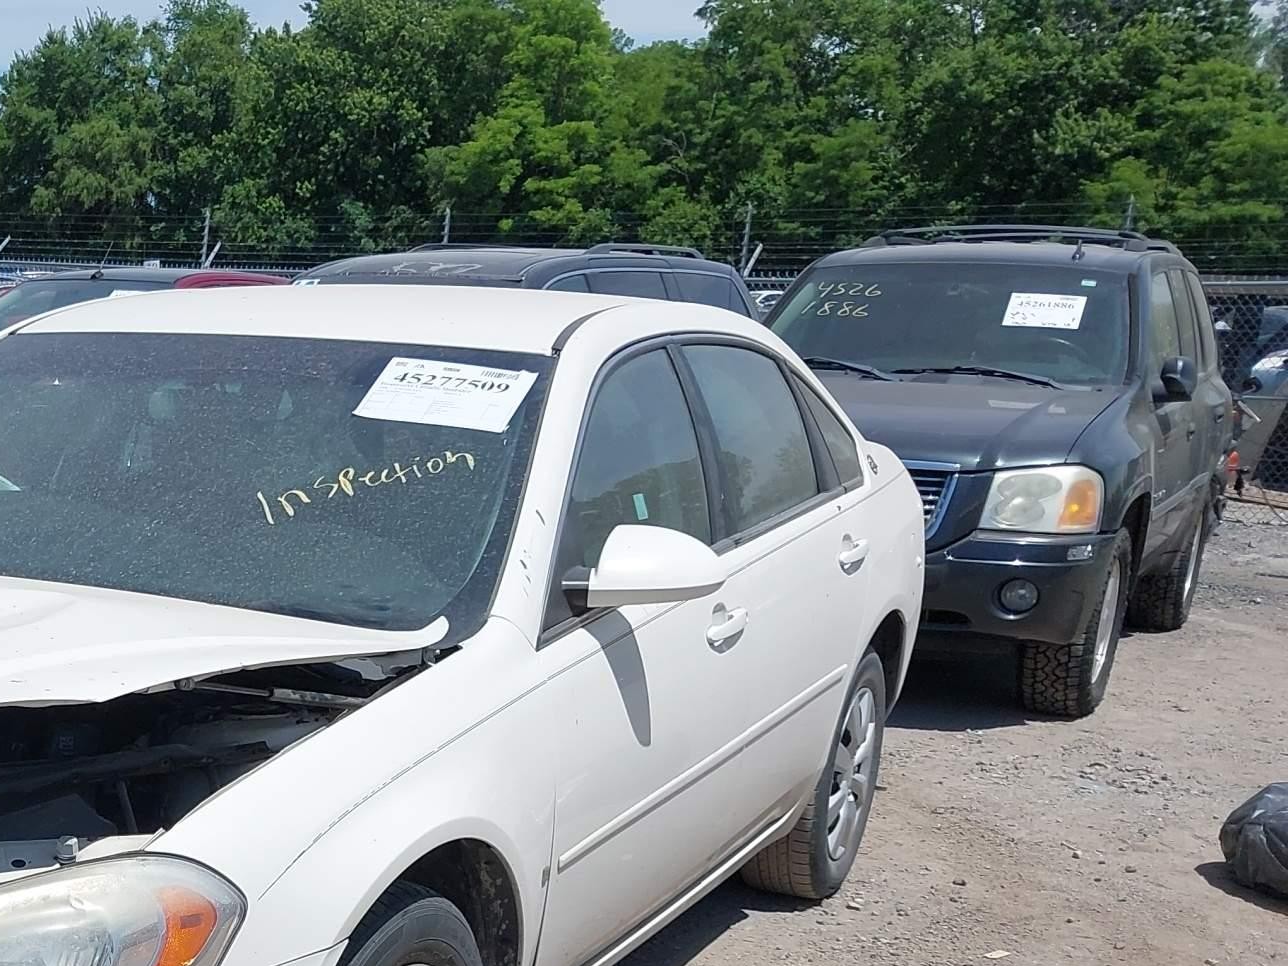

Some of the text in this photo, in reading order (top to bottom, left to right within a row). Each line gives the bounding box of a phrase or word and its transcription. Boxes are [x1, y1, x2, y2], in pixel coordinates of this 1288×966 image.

[817, 281, 882, 298] 4526
[800, 301, 869, 317] 1886
[393, 371, 510, 394] 45277509
[256, 450, 475, 526] Inspection
